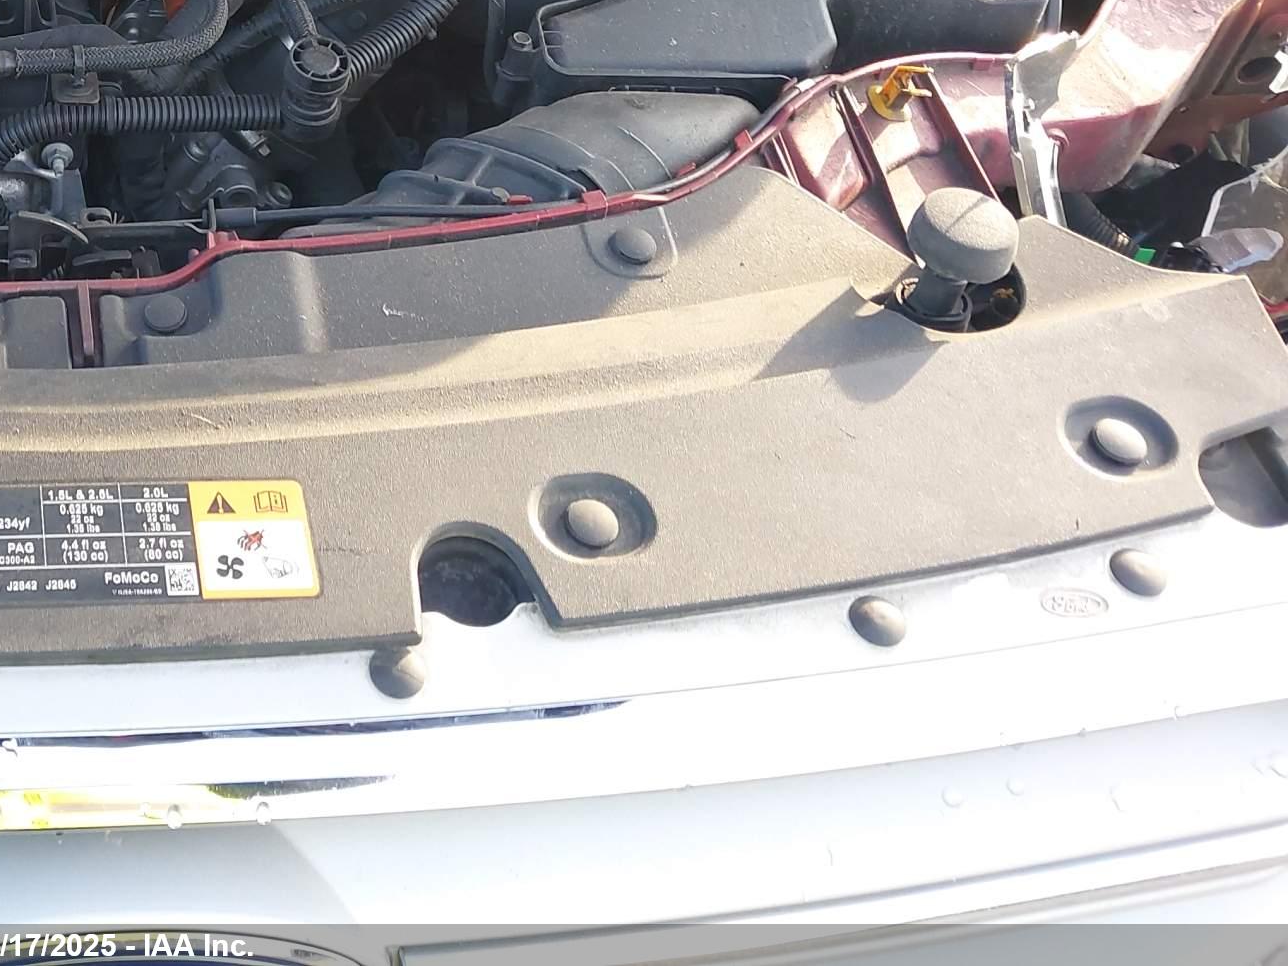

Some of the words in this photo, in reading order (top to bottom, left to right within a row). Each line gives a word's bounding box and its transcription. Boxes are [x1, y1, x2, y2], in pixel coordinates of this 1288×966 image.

[76, 489, 86, 500] &
[143, 487, 169, 499] 2.0L
[91, 503, 104, 517] kg
[166, 501, 180, 515] kg
[71, 515, 82, 524] 22
[83, 515, 95, 524] oz
[147, 513, 158, 522] 22
[159, 513, 171, 522] oz
[86, 524, 100, 533] lbs
[162, 522, 177, 532] lbs
[7, 542, 35, 554] PAG
[61, 539, 79, 550] 4.4
[81, 538, 90, 550] fl
[92, 541, 107, 550] oz
[139, 537, 156, 549] 2.7
[158, 537, 167, 549] fl
[169, 539, 185, 549] oz
[62, 550, 88, 564] (130
[104, 570, 159, 585] FoMoCo
